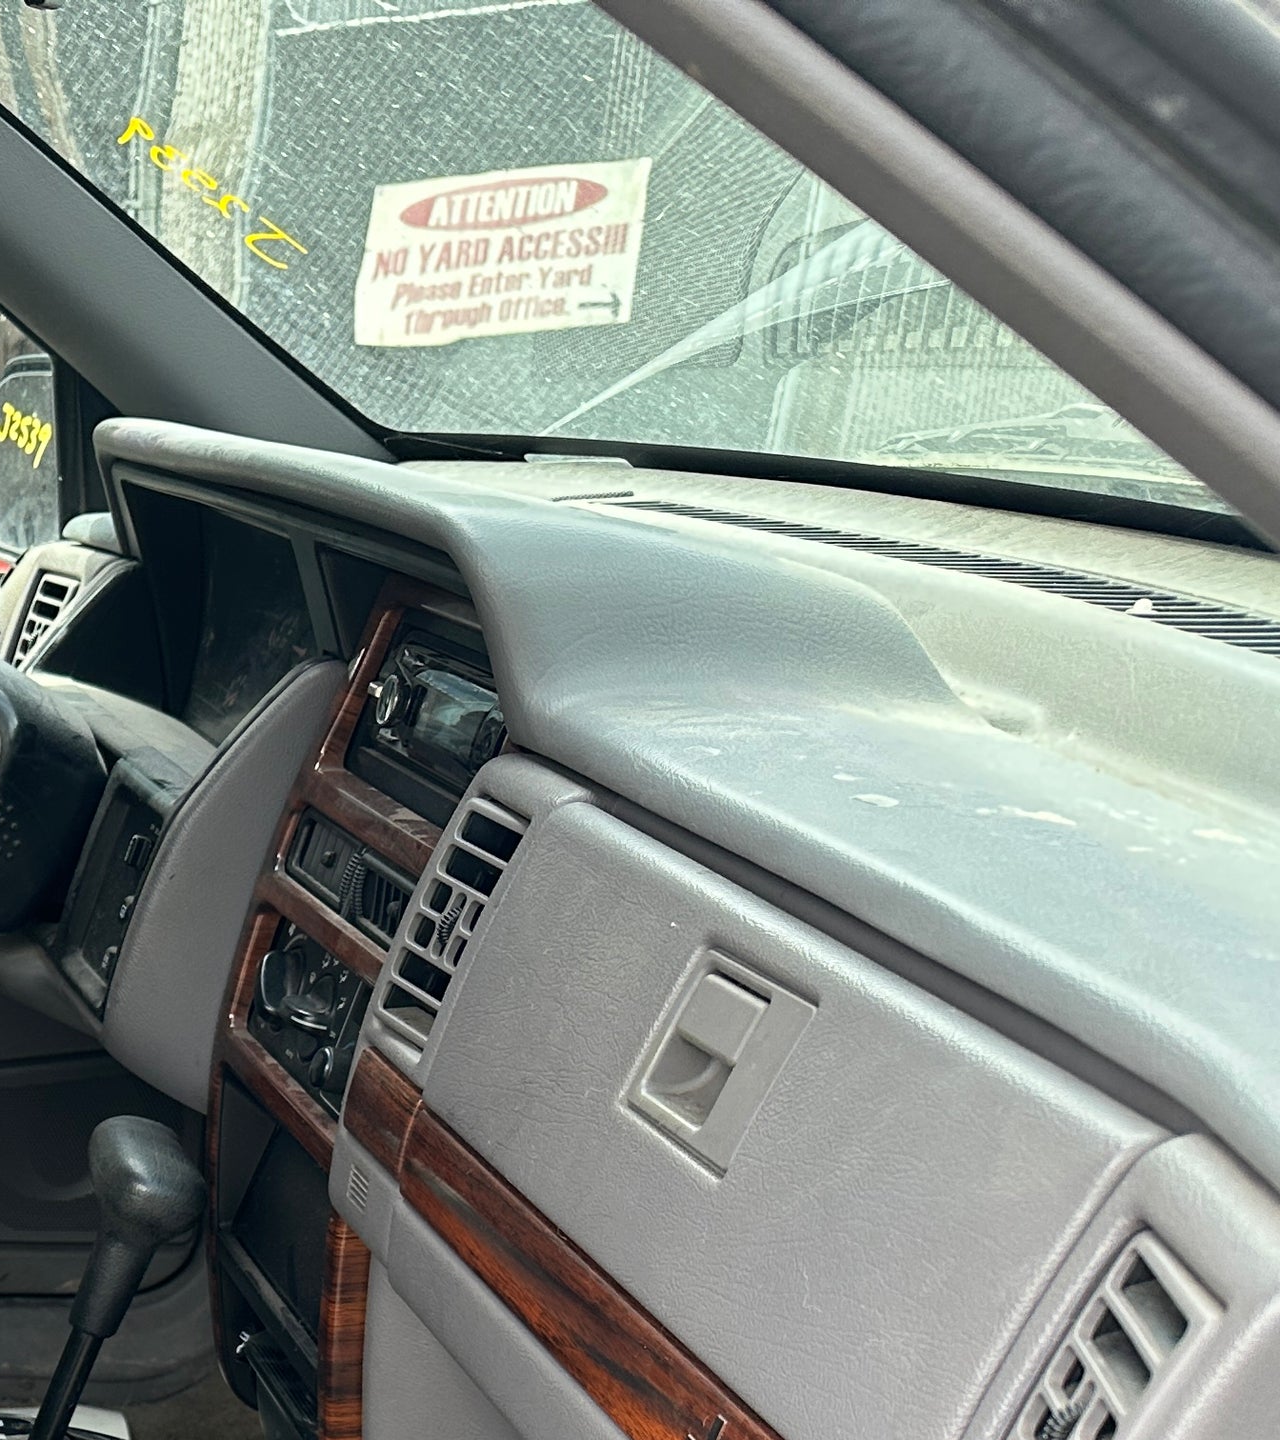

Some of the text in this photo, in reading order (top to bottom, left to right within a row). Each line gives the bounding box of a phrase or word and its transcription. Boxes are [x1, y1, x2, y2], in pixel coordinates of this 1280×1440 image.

[426, 180, 578, 227] ATTENTION
[372, 246, 409, 281] NO
[419, 236, 491, 276] YARD
[391, 263, 594, 310] Please Enter Yard
